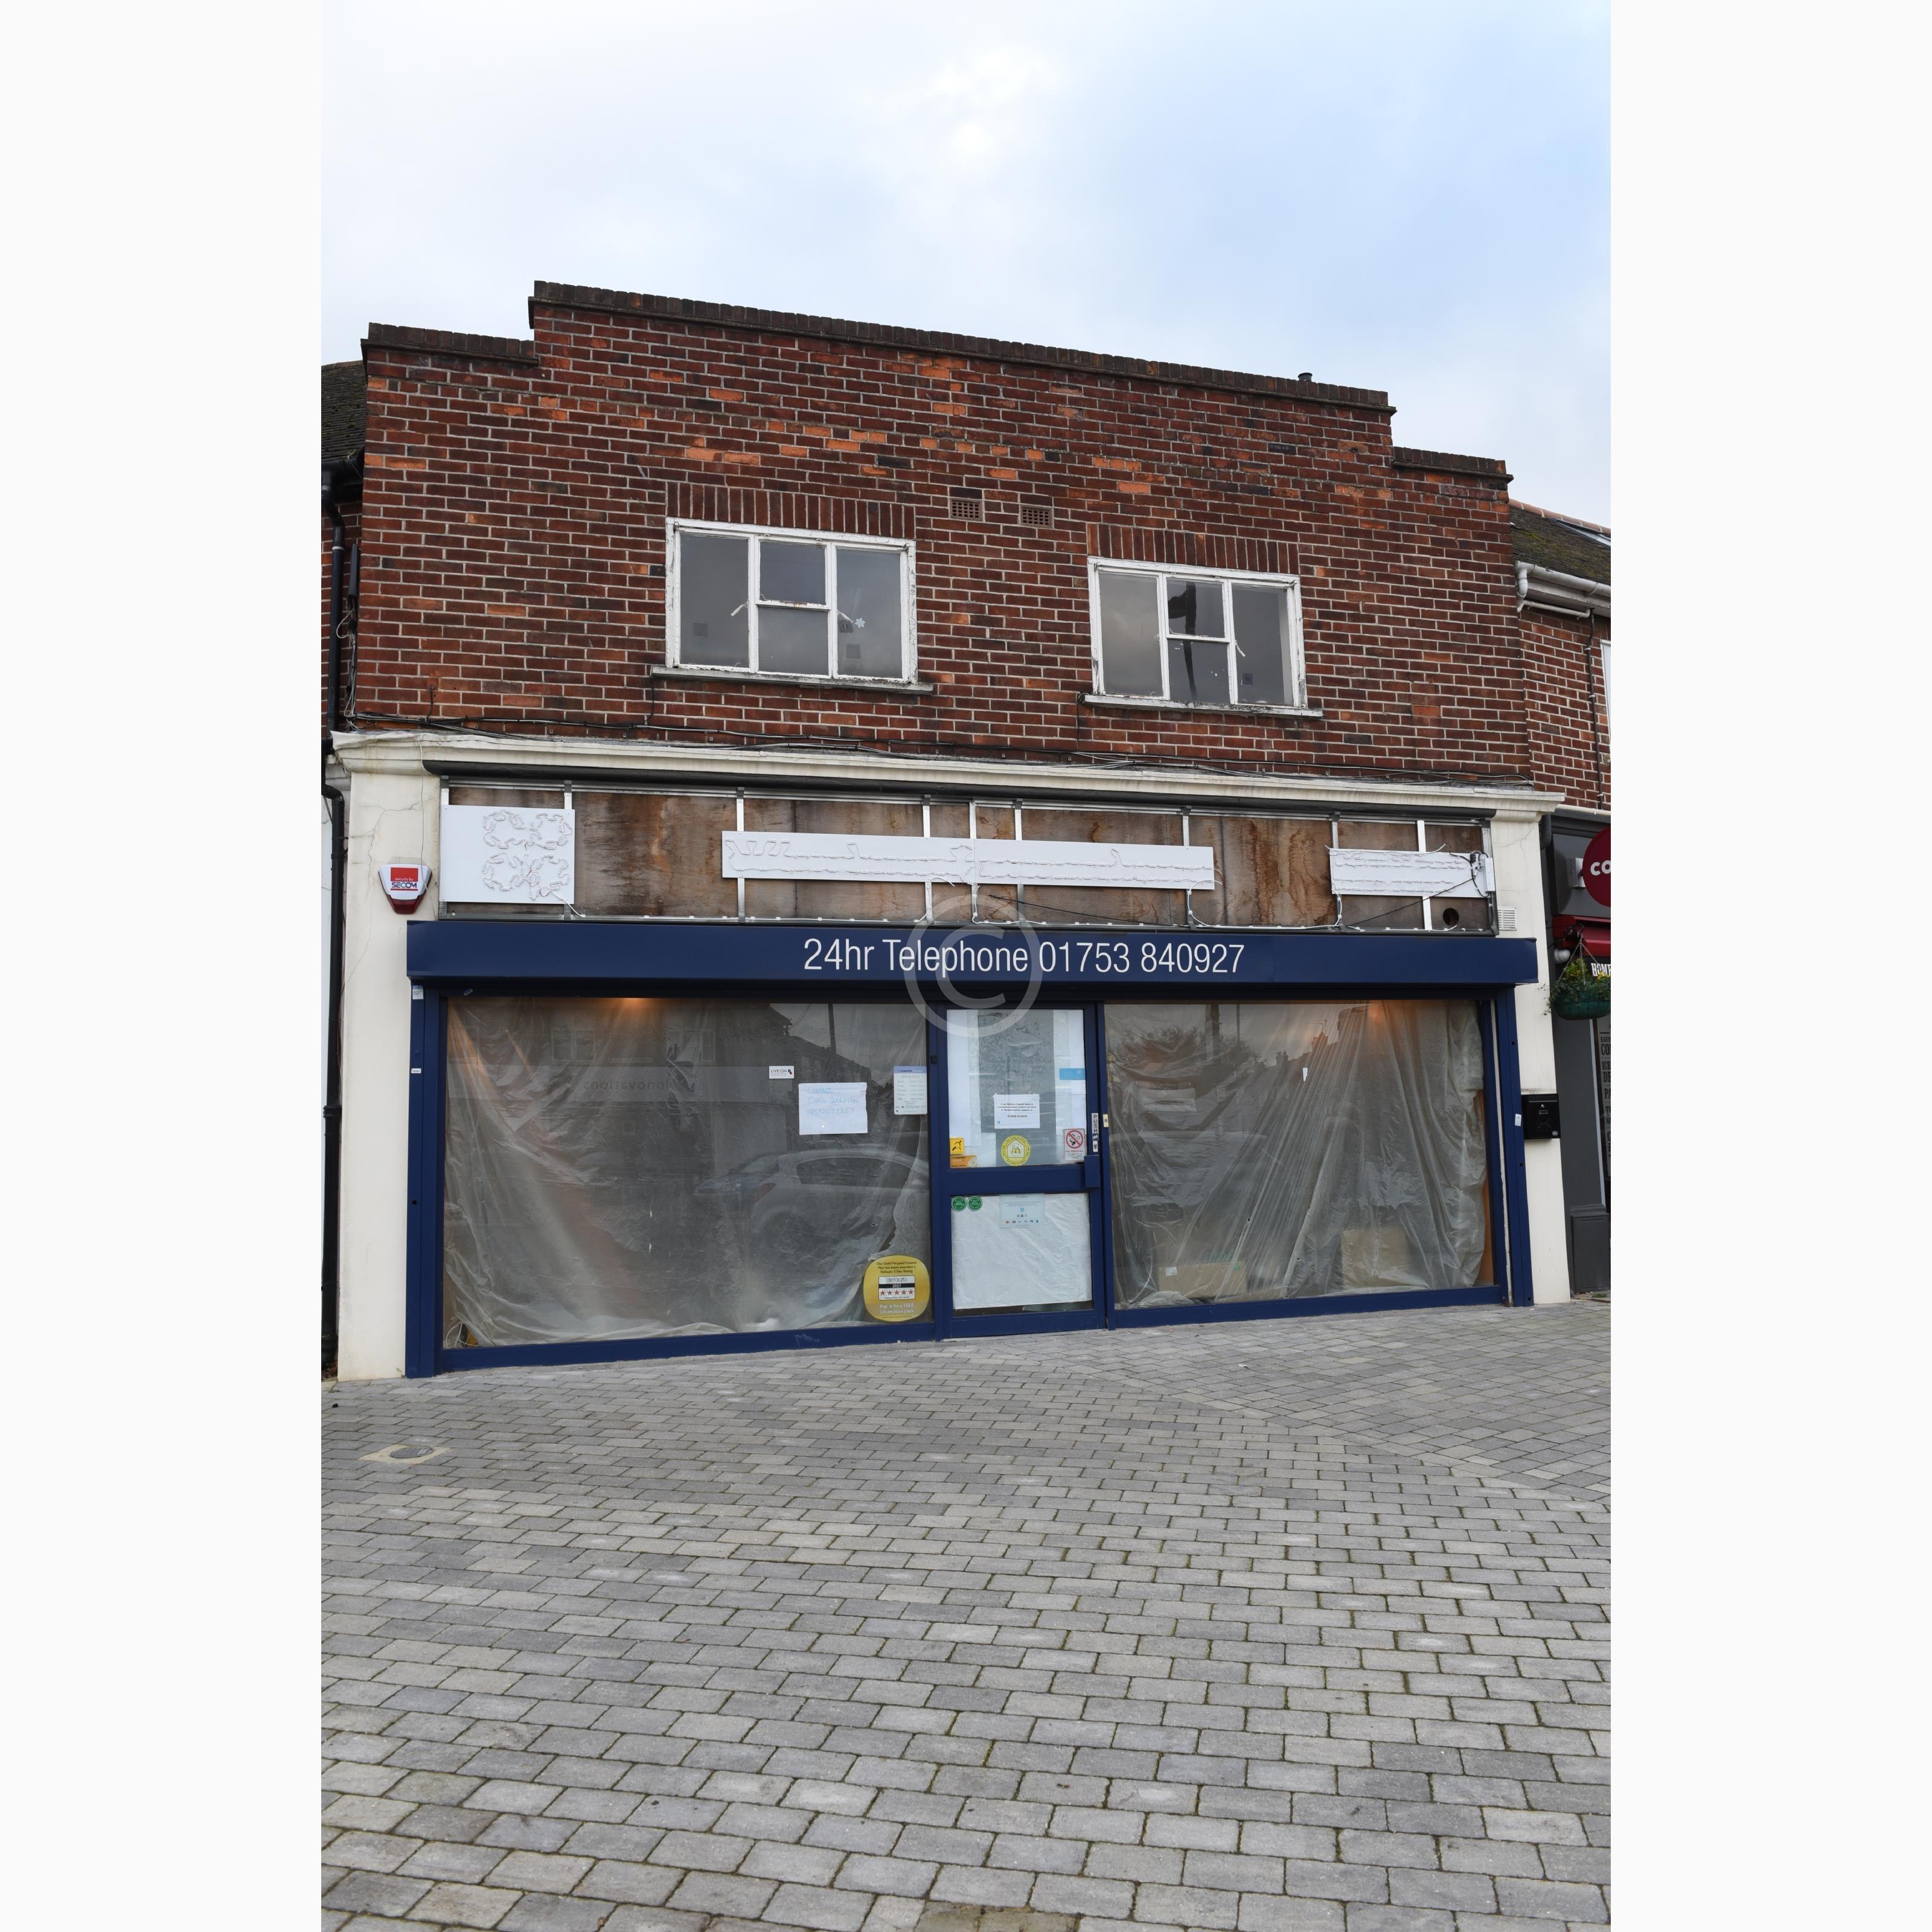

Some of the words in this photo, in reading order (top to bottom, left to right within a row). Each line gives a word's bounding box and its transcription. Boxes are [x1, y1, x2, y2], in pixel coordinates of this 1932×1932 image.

[804, 938, 874, 971] 24hr
[883, 939, 1028, 978] Telephone
[1039, 942, 1130, 973] 01753
[1142, 943, 1245, 973] 840927
